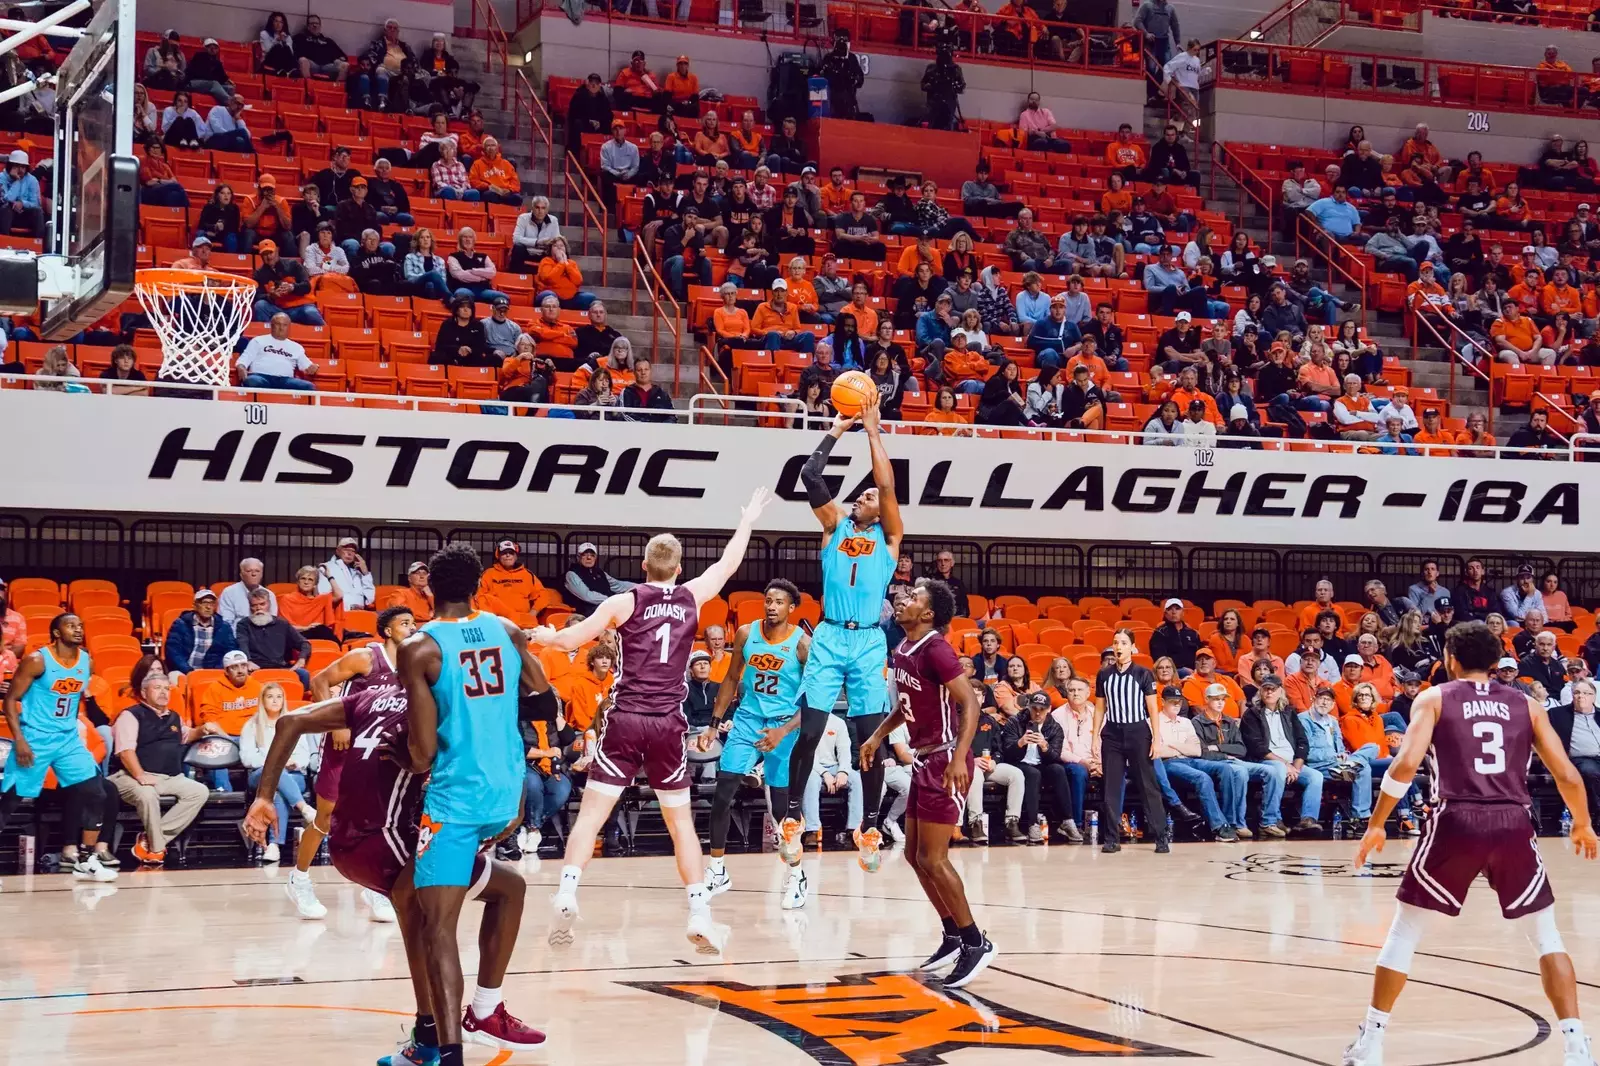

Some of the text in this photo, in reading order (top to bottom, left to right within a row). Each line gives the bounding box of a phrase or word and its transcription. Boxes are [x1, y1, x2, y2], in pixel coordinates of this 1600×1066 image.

[1467, 111, 1490, 132] 204
[244, 404, 268, 424] 101
[148, 427, 719, 498] HISTORIC
[1194, 449, 1214, 466] 102
[838, 536, 876, 557] OSU
[643, 603, 687, 623] DOMASK
[461, 626, 486, 643] CISSE
[655, 622, 671, 664] 1
[459, 646, 505, 698] 33
[748, 653, 784, 671] OSU
[754, 673, 779, 695] 22
[893, 667, 922, 692] LUKIS
[55, 697, 71, 717] 51
[1462, 700, 1511, 721] BANKS
[352, 716, 386, 760] 4
[1472, 721, 1506, 775] 3
